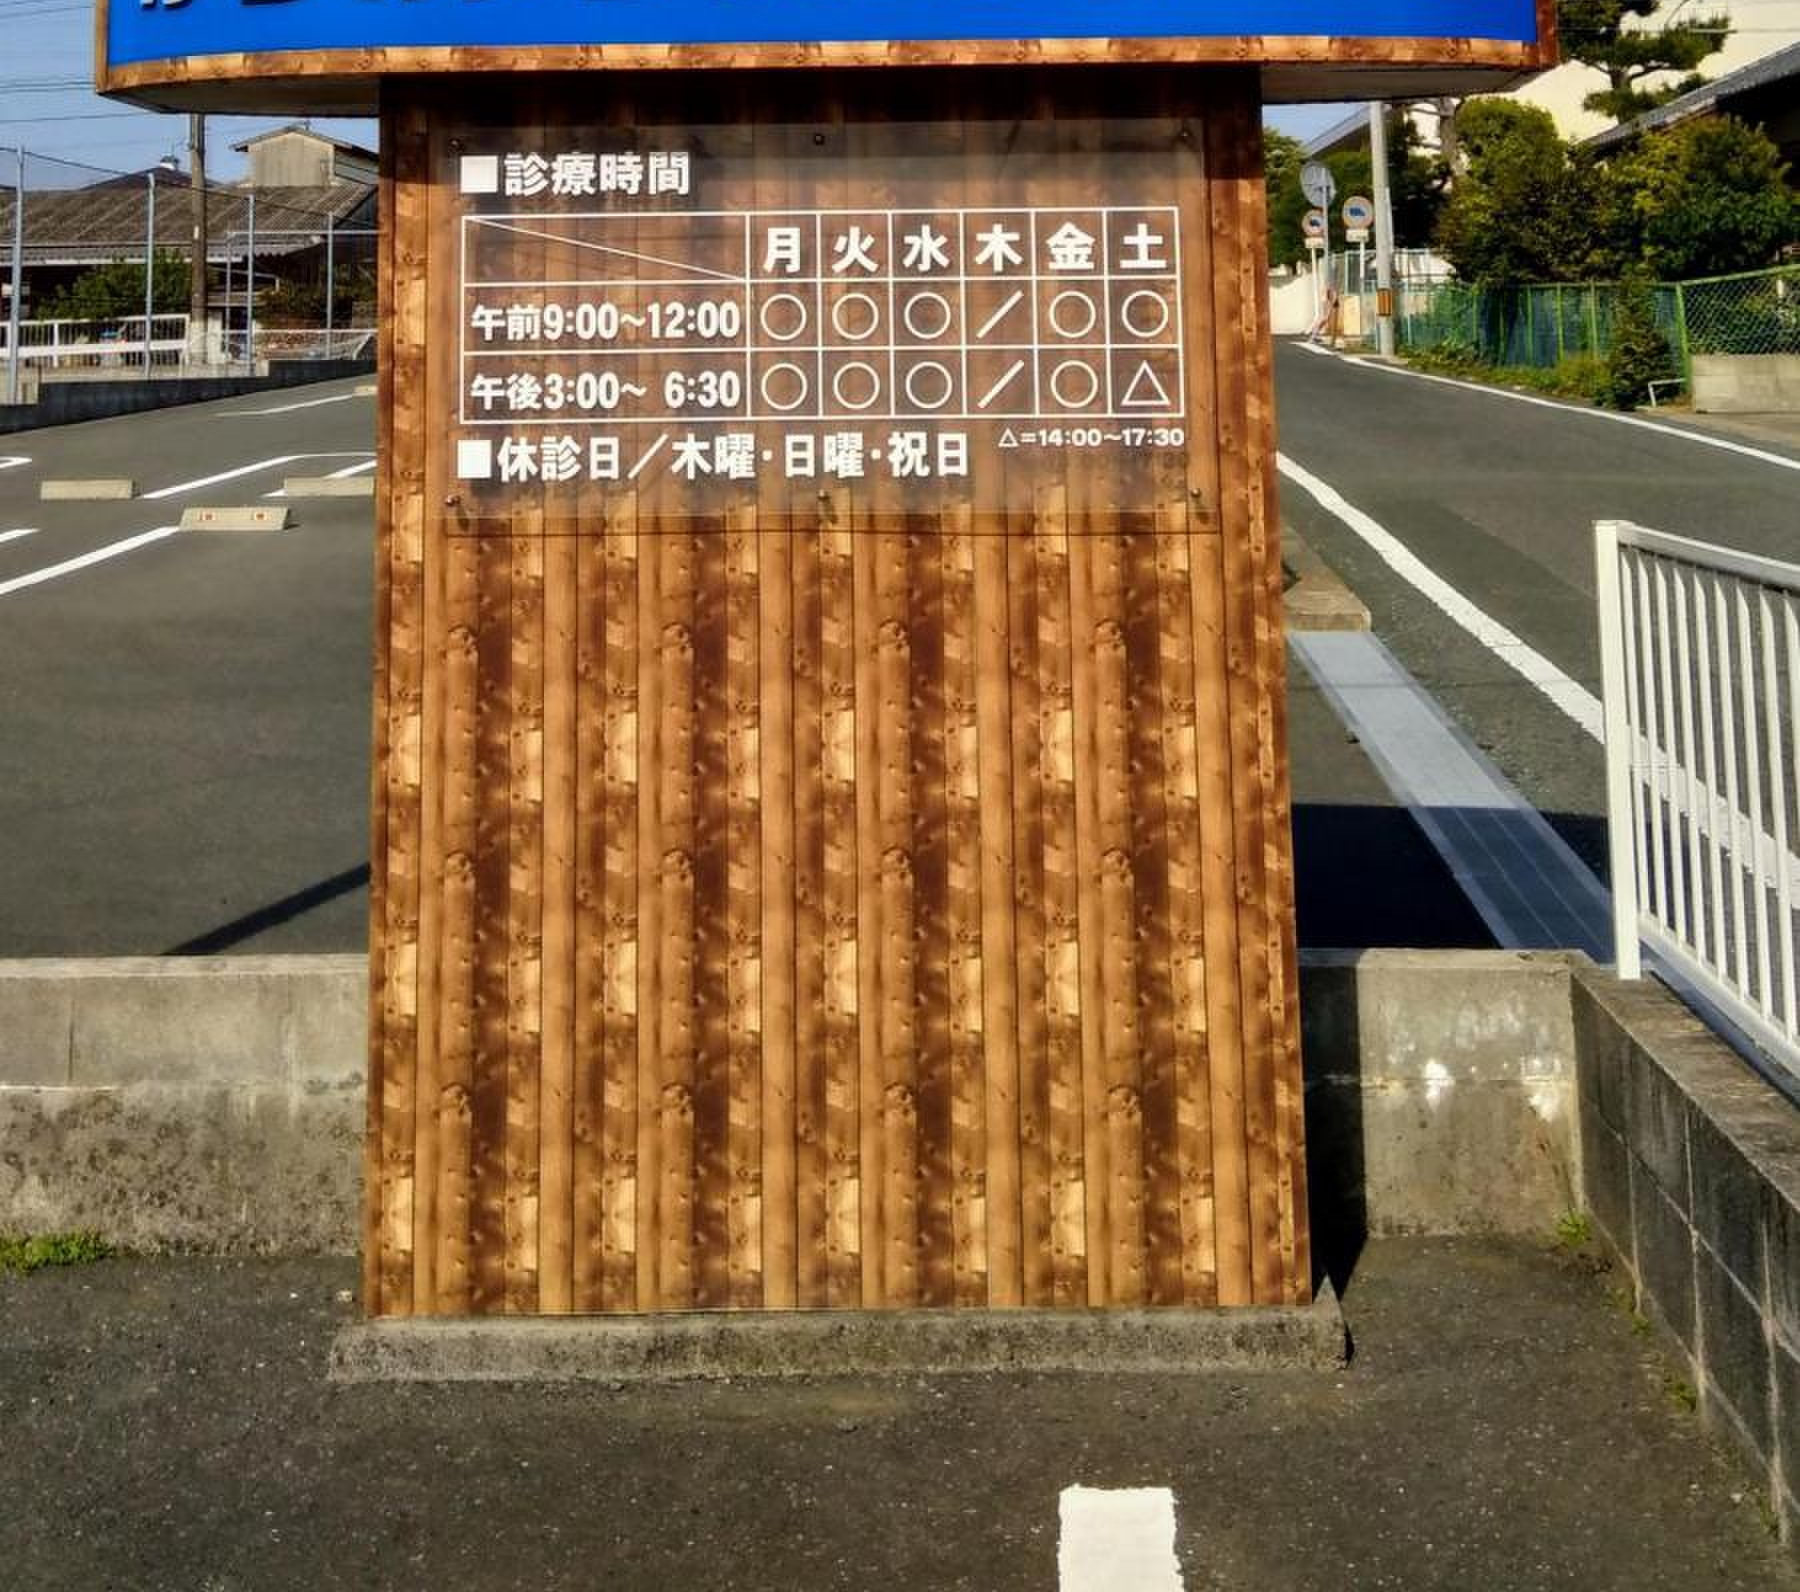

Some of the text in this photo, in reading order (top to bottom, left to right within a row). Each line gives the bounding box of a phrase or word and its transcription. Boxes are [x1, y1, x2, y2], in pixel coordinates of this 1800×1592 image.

[503, 152, 691, 197] 診療時間
[762, 222, 1168, 274] 月 火 水 木 金 土
[664, 369, 742, 410] 6:30
